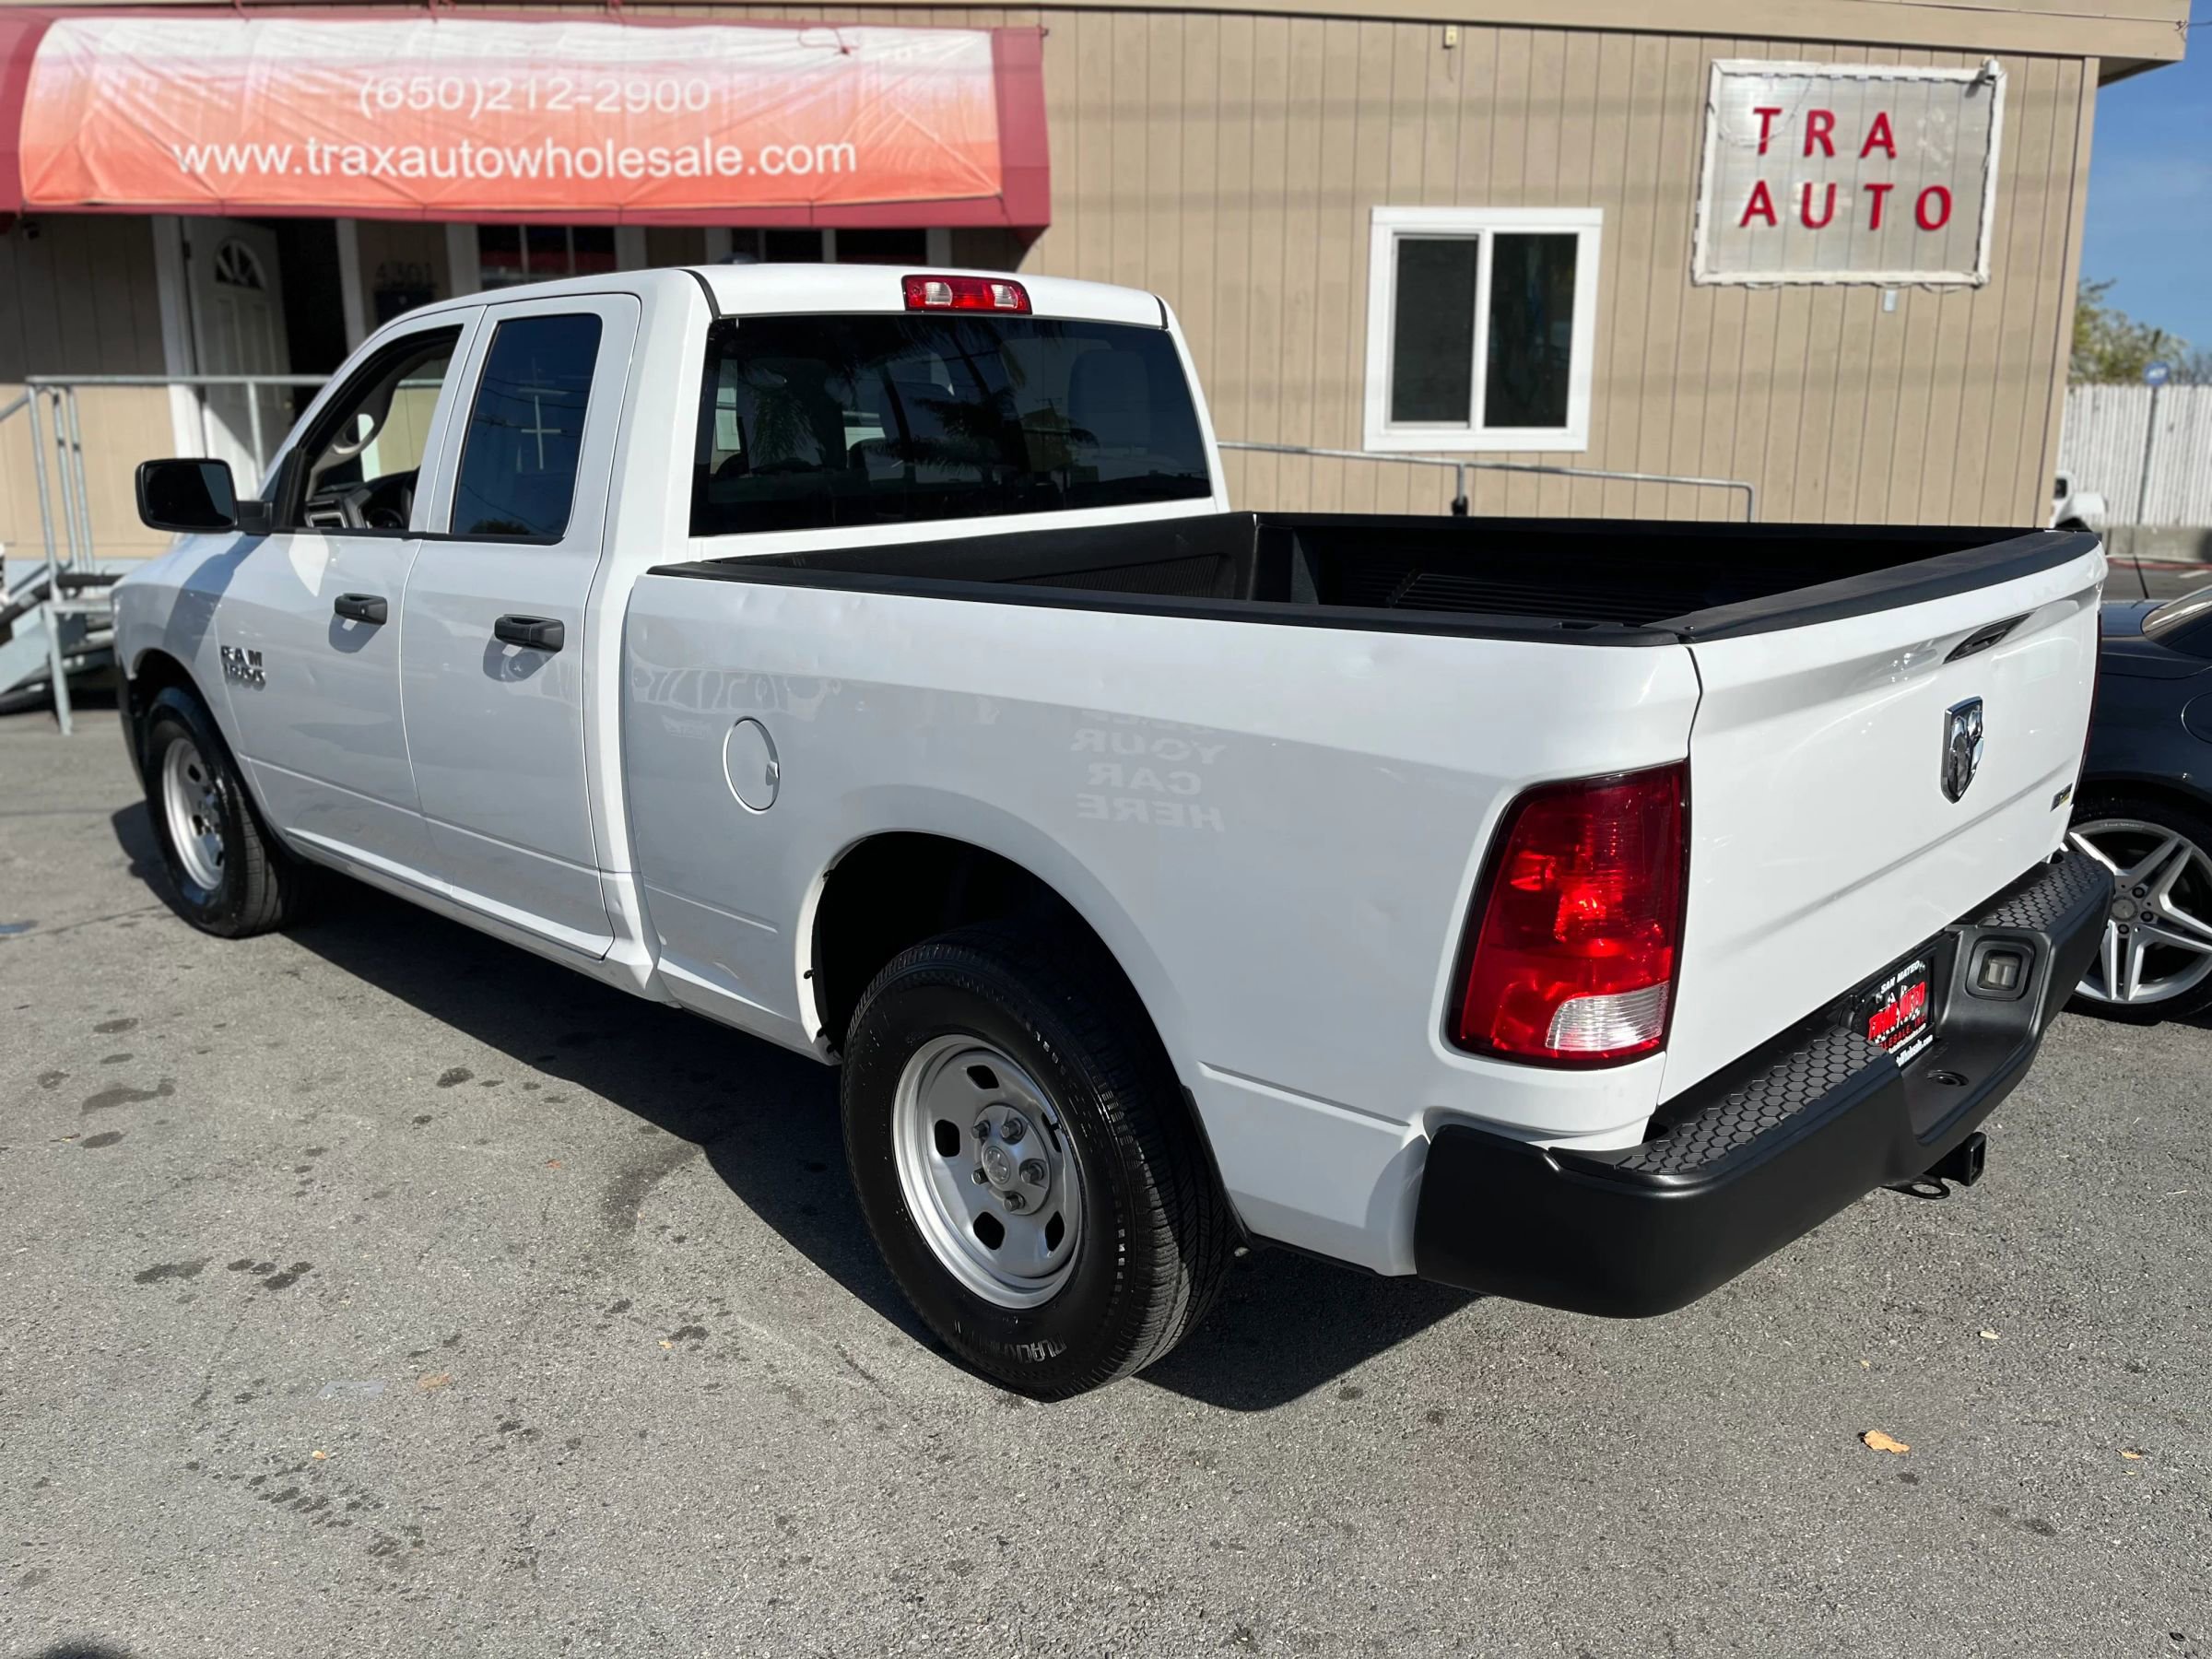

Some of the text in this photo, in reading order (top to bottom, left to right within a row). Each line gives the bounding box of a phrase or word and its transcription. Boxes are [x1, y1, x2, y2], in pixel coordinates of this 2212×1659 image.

[359, 76, 712, 120] (650)212-2900
[1753, 107, 1897, 159] TRA
[172, 136, 858, 179] www.traxautowholesale.com
[1738, 180, 1952, 231] AUTO
